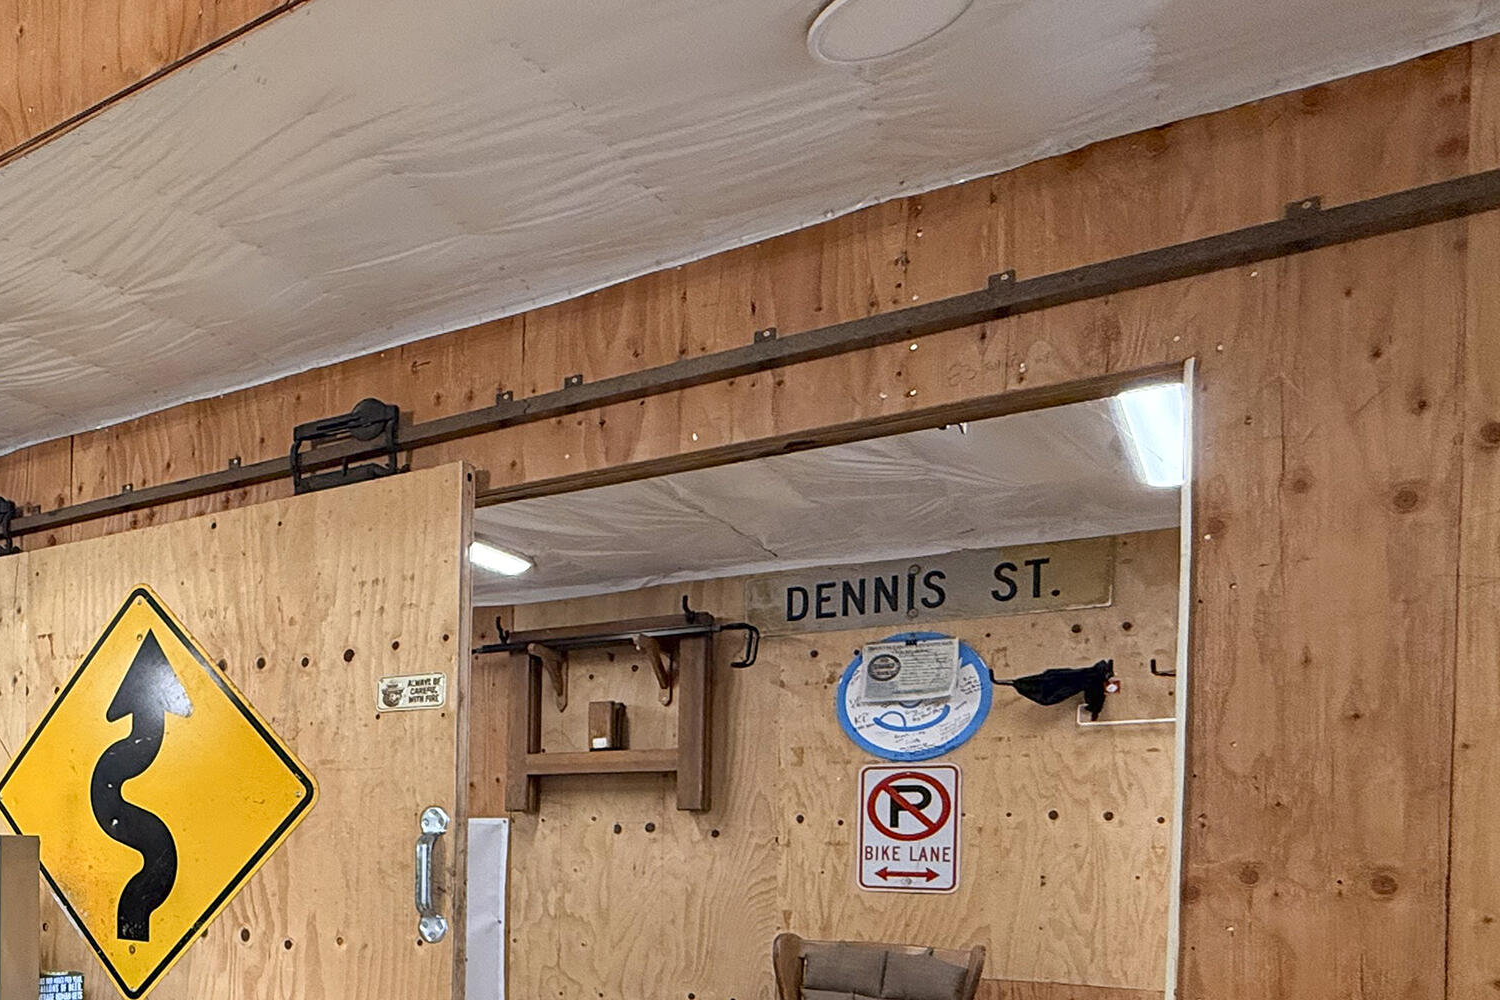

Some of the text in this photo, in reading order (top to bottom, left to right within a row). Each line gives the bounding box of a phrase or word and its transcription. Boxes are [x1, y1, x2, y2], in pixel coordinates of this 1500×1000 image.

[786, 557, 1061, 622] DENNIS ST.
[408, 677, 442, 687] ALWAYS BE
[410, 686, 437, 695] CAREFUL
[408, 694, 439, 703] WITH FIRE
[889, 784, 933, 828] P
[864, 845, 951, 862] BIKE LANE
